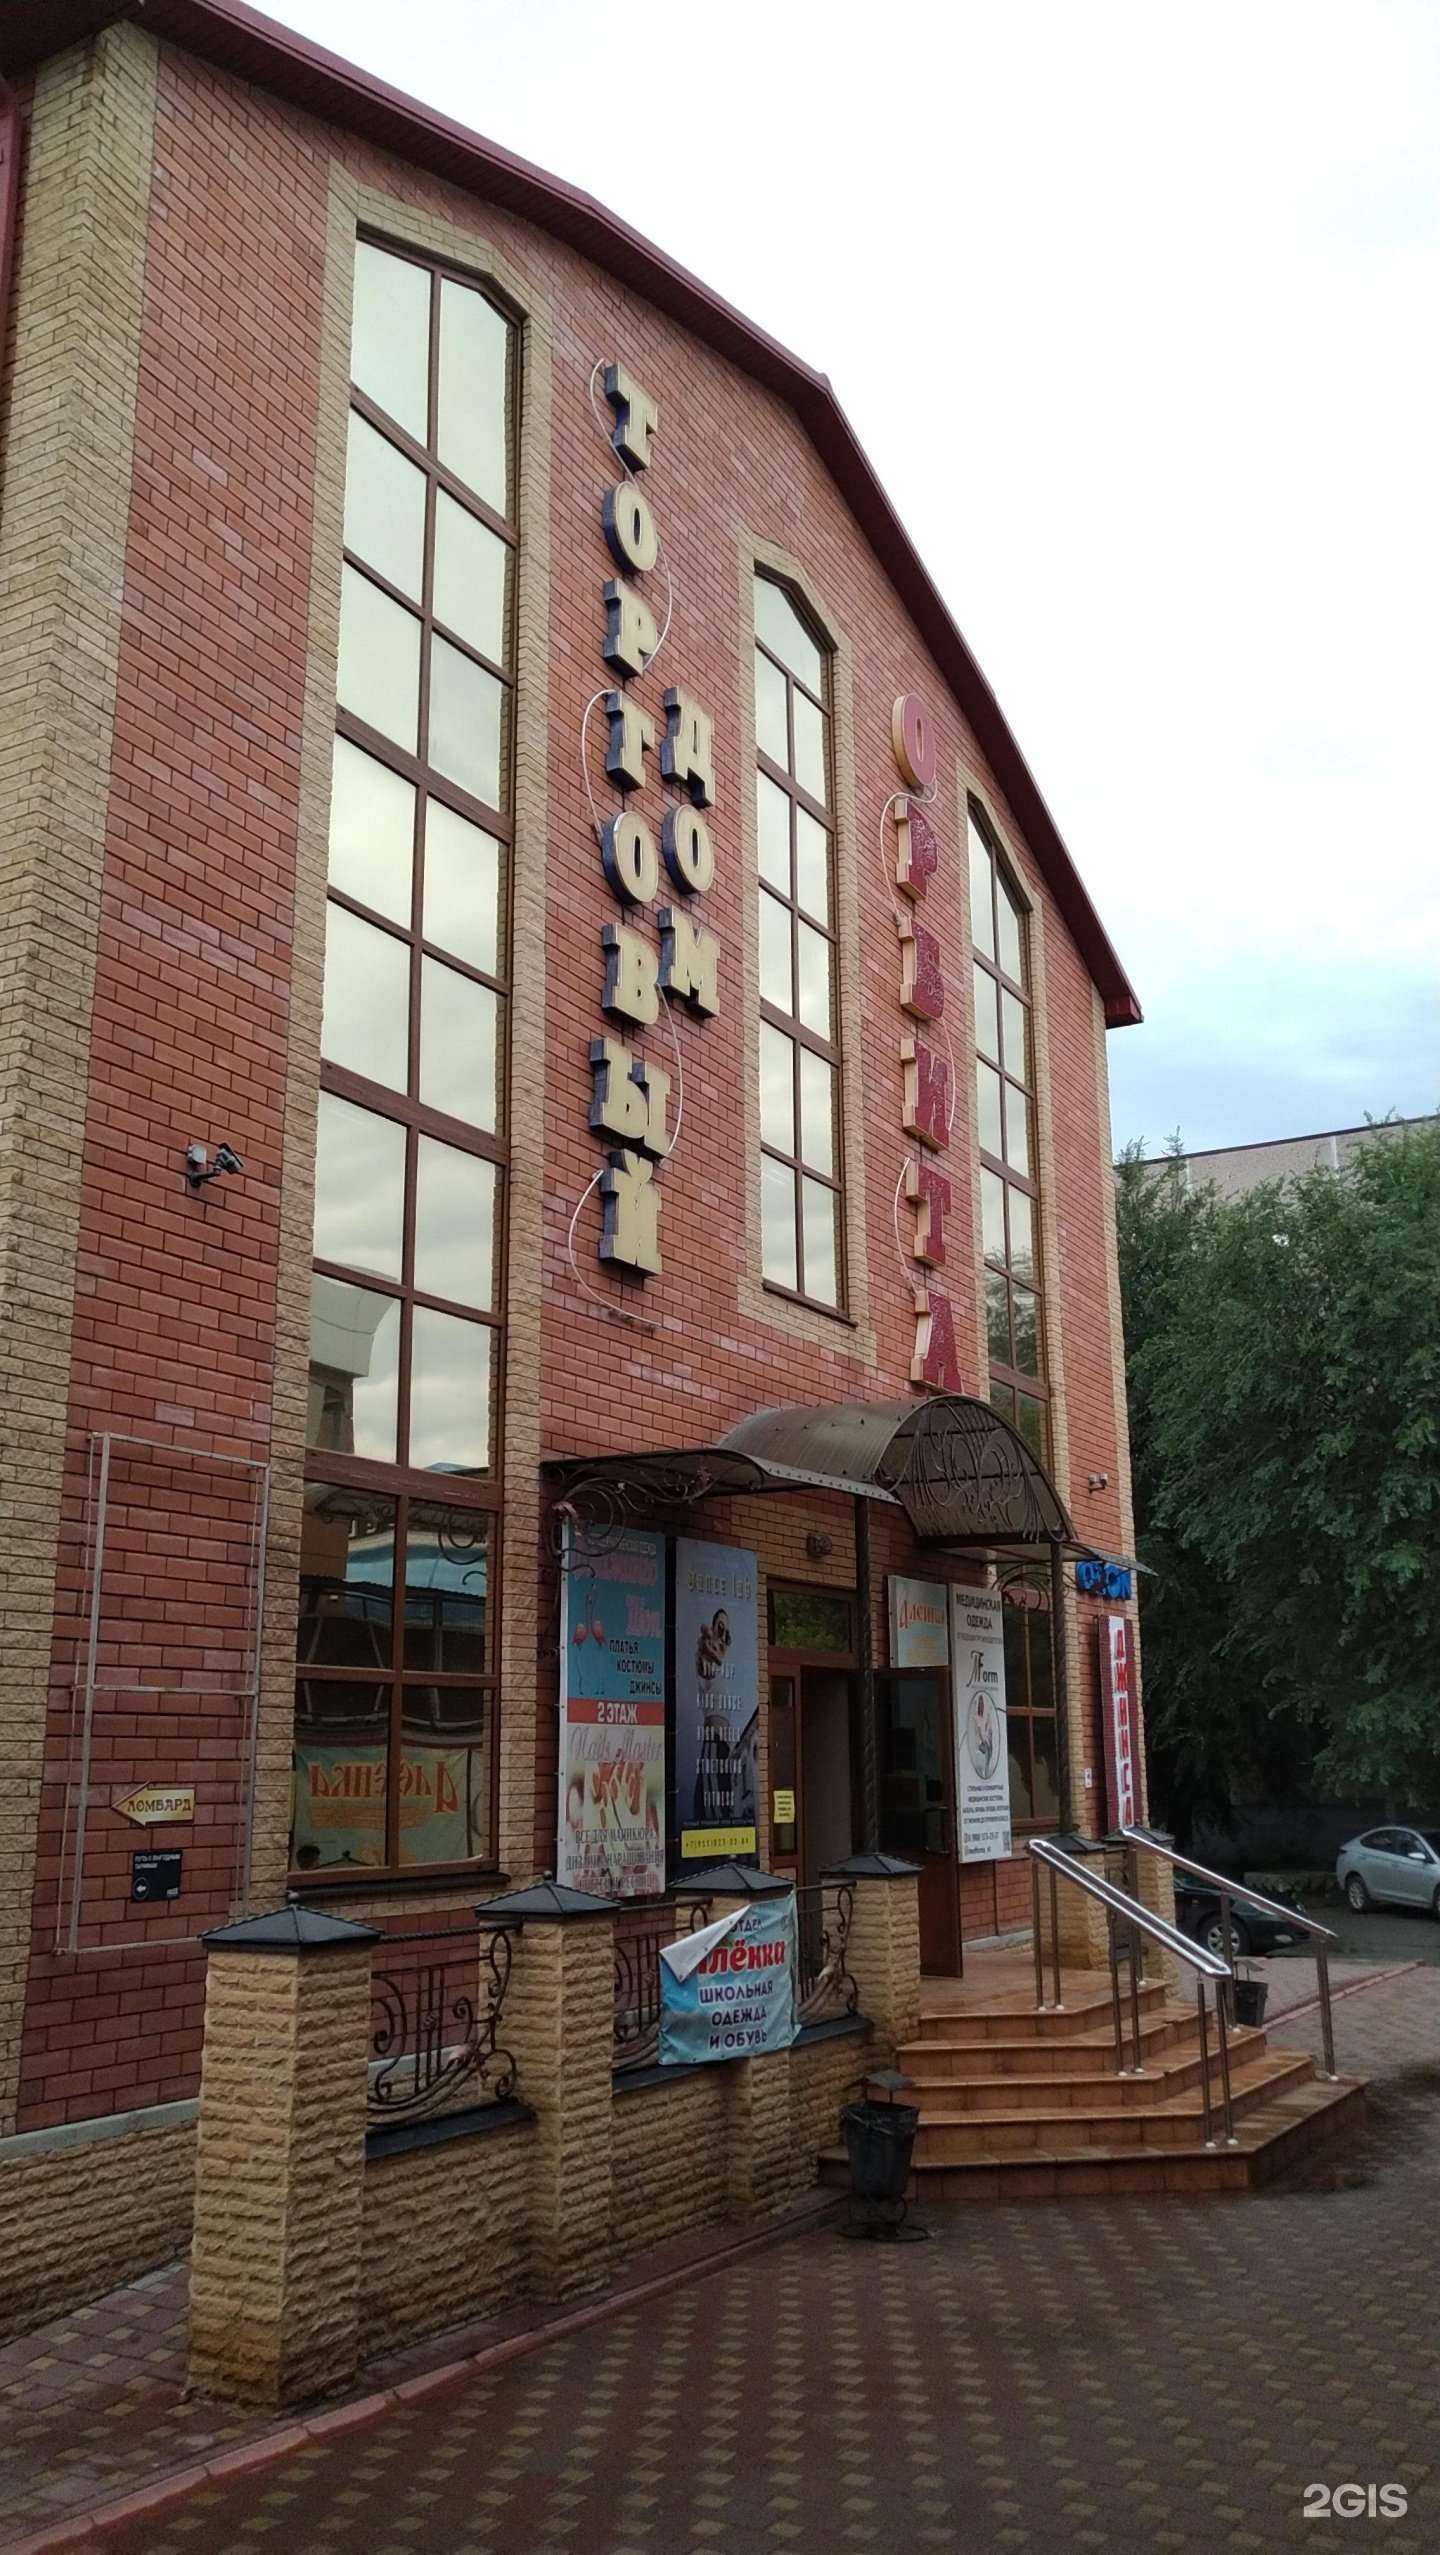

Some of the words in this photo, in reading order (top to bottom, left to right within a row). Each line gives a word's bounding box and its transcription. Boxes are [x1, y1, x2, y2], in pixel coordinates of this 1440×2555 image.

[591, 362, 671, 1277] ТОРГОВЫЙ
[658, 686, 720, 1018] ДОМ
[892, 692, 963, 1394] ОРБИТА
[966, 1614, 993, 1630] ОДЕЖДА
[609, 1639, 639, 1655] ПЛАТЬЯ
[616, 1659, 655, 1674] КОСТЮМЫ
[629, 1680, 662, 1696] ДЖИНСЫ
[597, 1704, 605, 1722] 2
[607, 1704, 638, 1723] ЭТАЖ
[127, 1798, 192, 1813] ЛОМБАРД
[700, 1980, 773, 2004] ШКОЛЬНАЯ
[711, 2005, 768, 2026] ОДЕЖДА
[709, 2034, 719, 2049] И
[724, 2030, 768, 2048] ОБУВЬ
